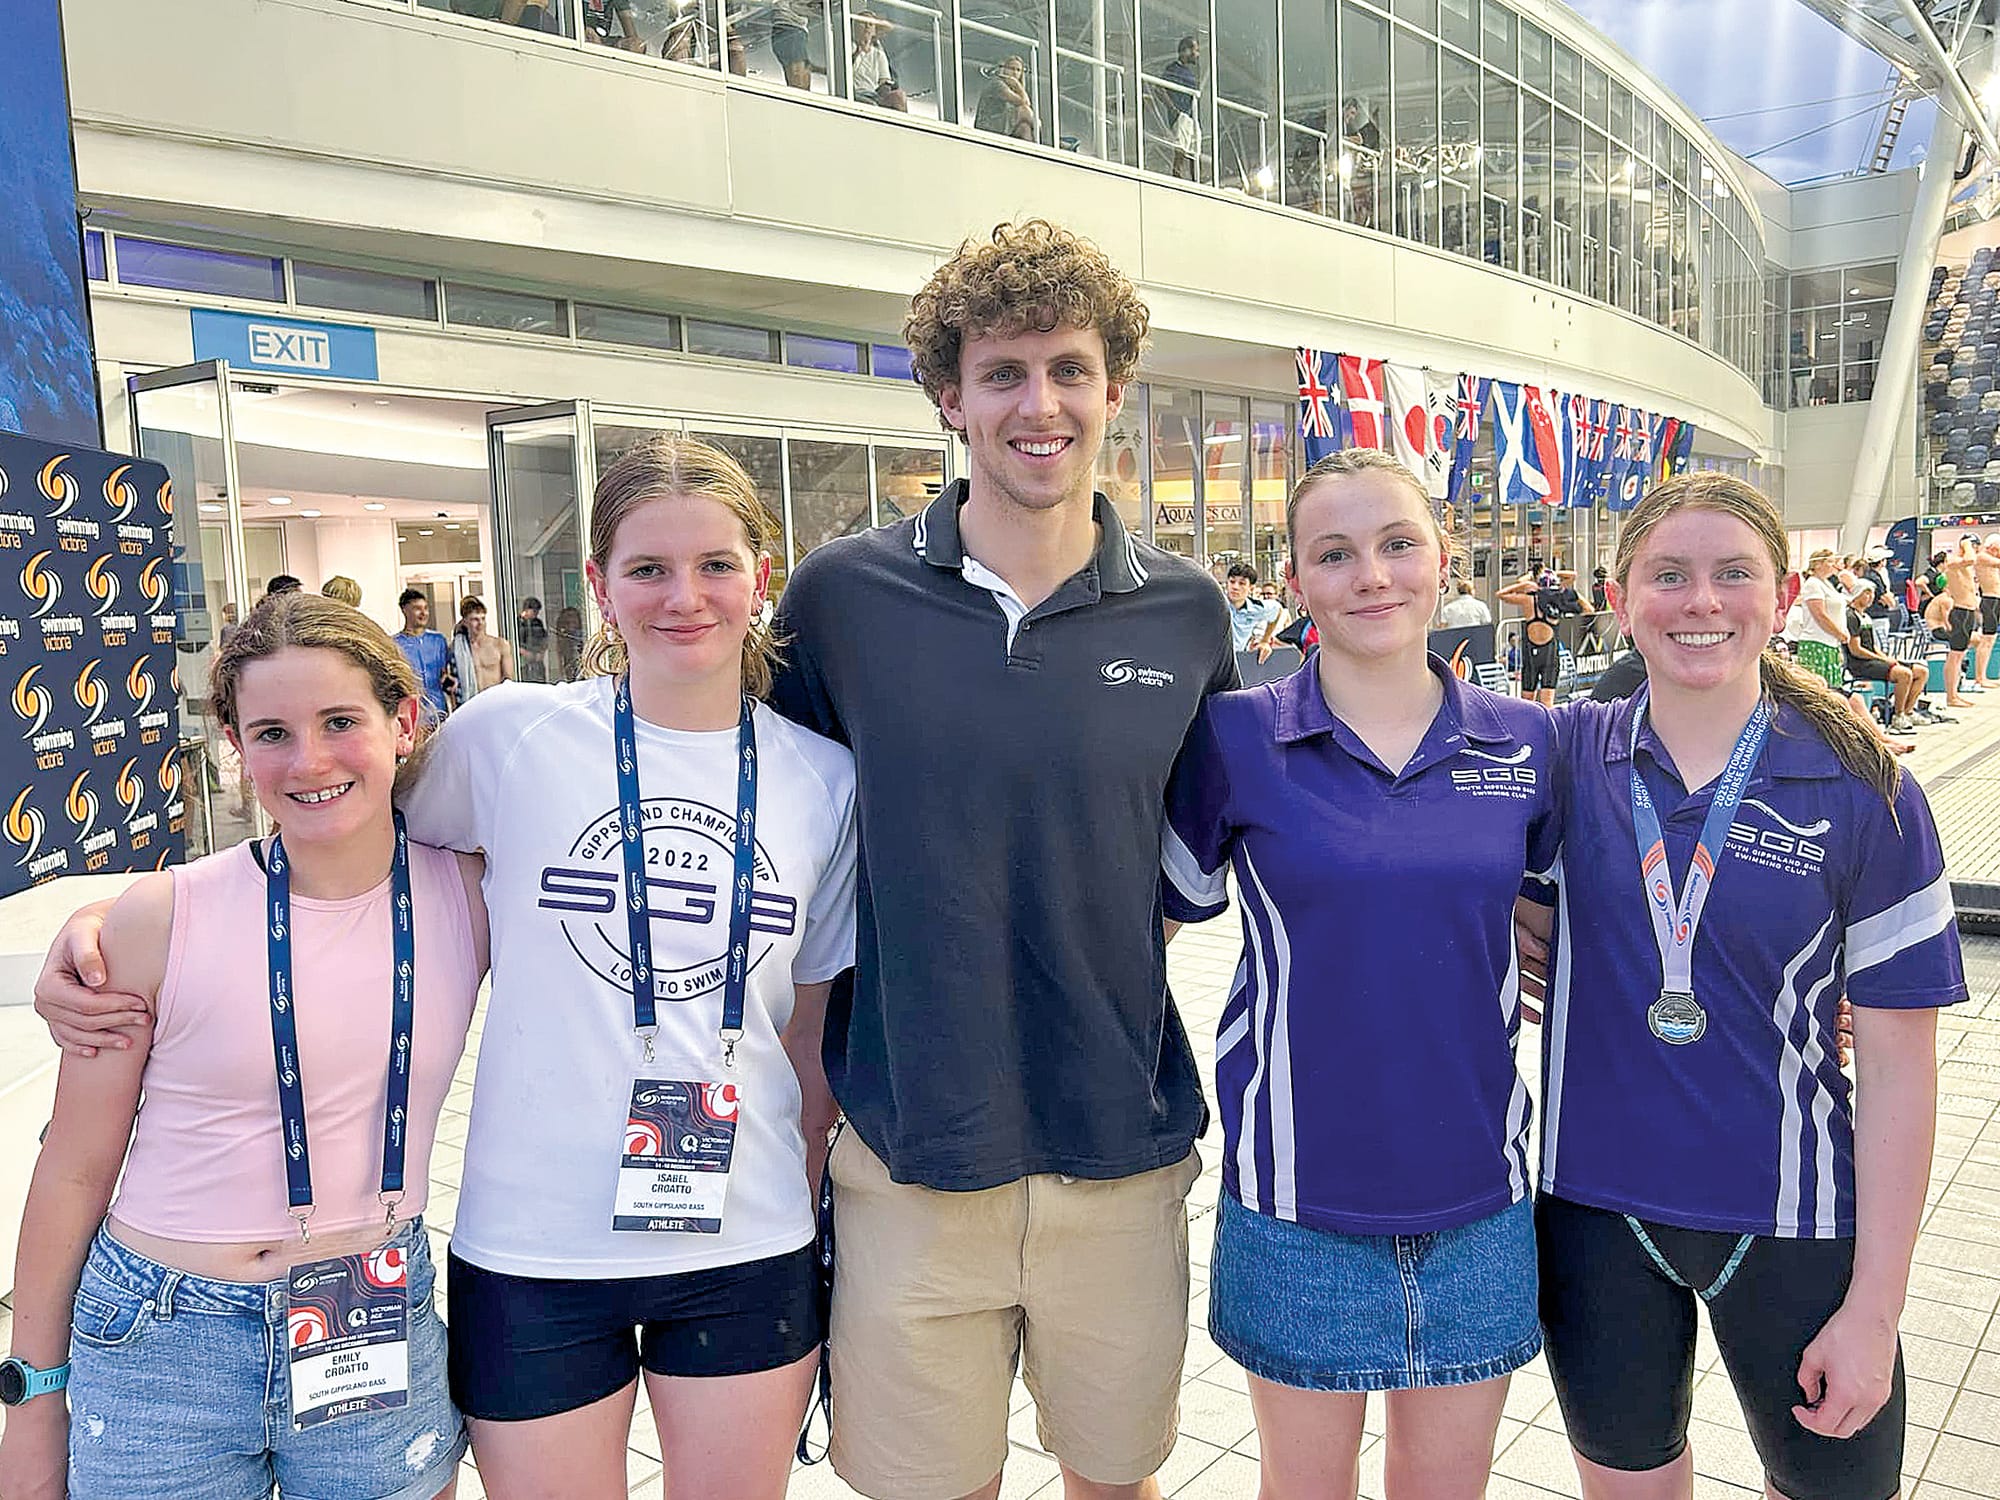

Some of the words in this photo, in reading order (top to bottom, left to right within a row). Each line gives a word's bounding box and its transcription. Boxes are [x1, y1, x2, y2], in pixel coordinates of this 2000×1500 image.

[251, 330, 326, 363] EXIT
[56, 515, 100, 540] swimming
[117, 521, 153, 544] swimming
[40, 612, 84, 636] swimming
[101, 611, 136, 633] swimming
[1137, 667, 1174, 683] swimming
[33, 727, 75, 752] swimming
[91, 716, 126, 740] swimming
[1714, 785, 1729, 807] 2025
[1724, 740, 1748, 783] VICTORIAN
[1743, 723, 1757, 740] AGE
[1753, 700, 1765, 724] LON
[1451, 767, 1537, 785] SGB
[1725, 772, 1744, 807] COURSE
[581, 806, 663, 860] GIPPSND
[1727, 822, 1826, 862] SGB
[28, 847, 68, 878] swimming
[648, 847, 709, 871] 2022
[1725, 841, 1749, 853] OUTH
[1752, 849, 1801, 867] GIPPSLAND
[1735, 852, 1782, 869] SWIMMING
[1785, 865, 1807, 876] CLUB
[610, 962, 632, 982] LO
[658, 980, 678, 994] TO
[684, 967, 724, 992] SWIM
[651, 1184, 692, 1194] CROATTO
[657, 1173, 688, 1183] ISABEL
[655, 1202, 687, 1210] GIPPSLAND
[647, 1220, 686, 1230] ATHLETE
[325, 1362, 369, 1378] CROATTO
[332, 1352, 361, 1365] EMILY
[309, 1390, 329, 1400] SOUTH
[331, 1382, 367, 1394] GIPPSLAND
[369, 1378, 387, 1387] BASS
[327, 1400, 368, 1417] ATHLETE
